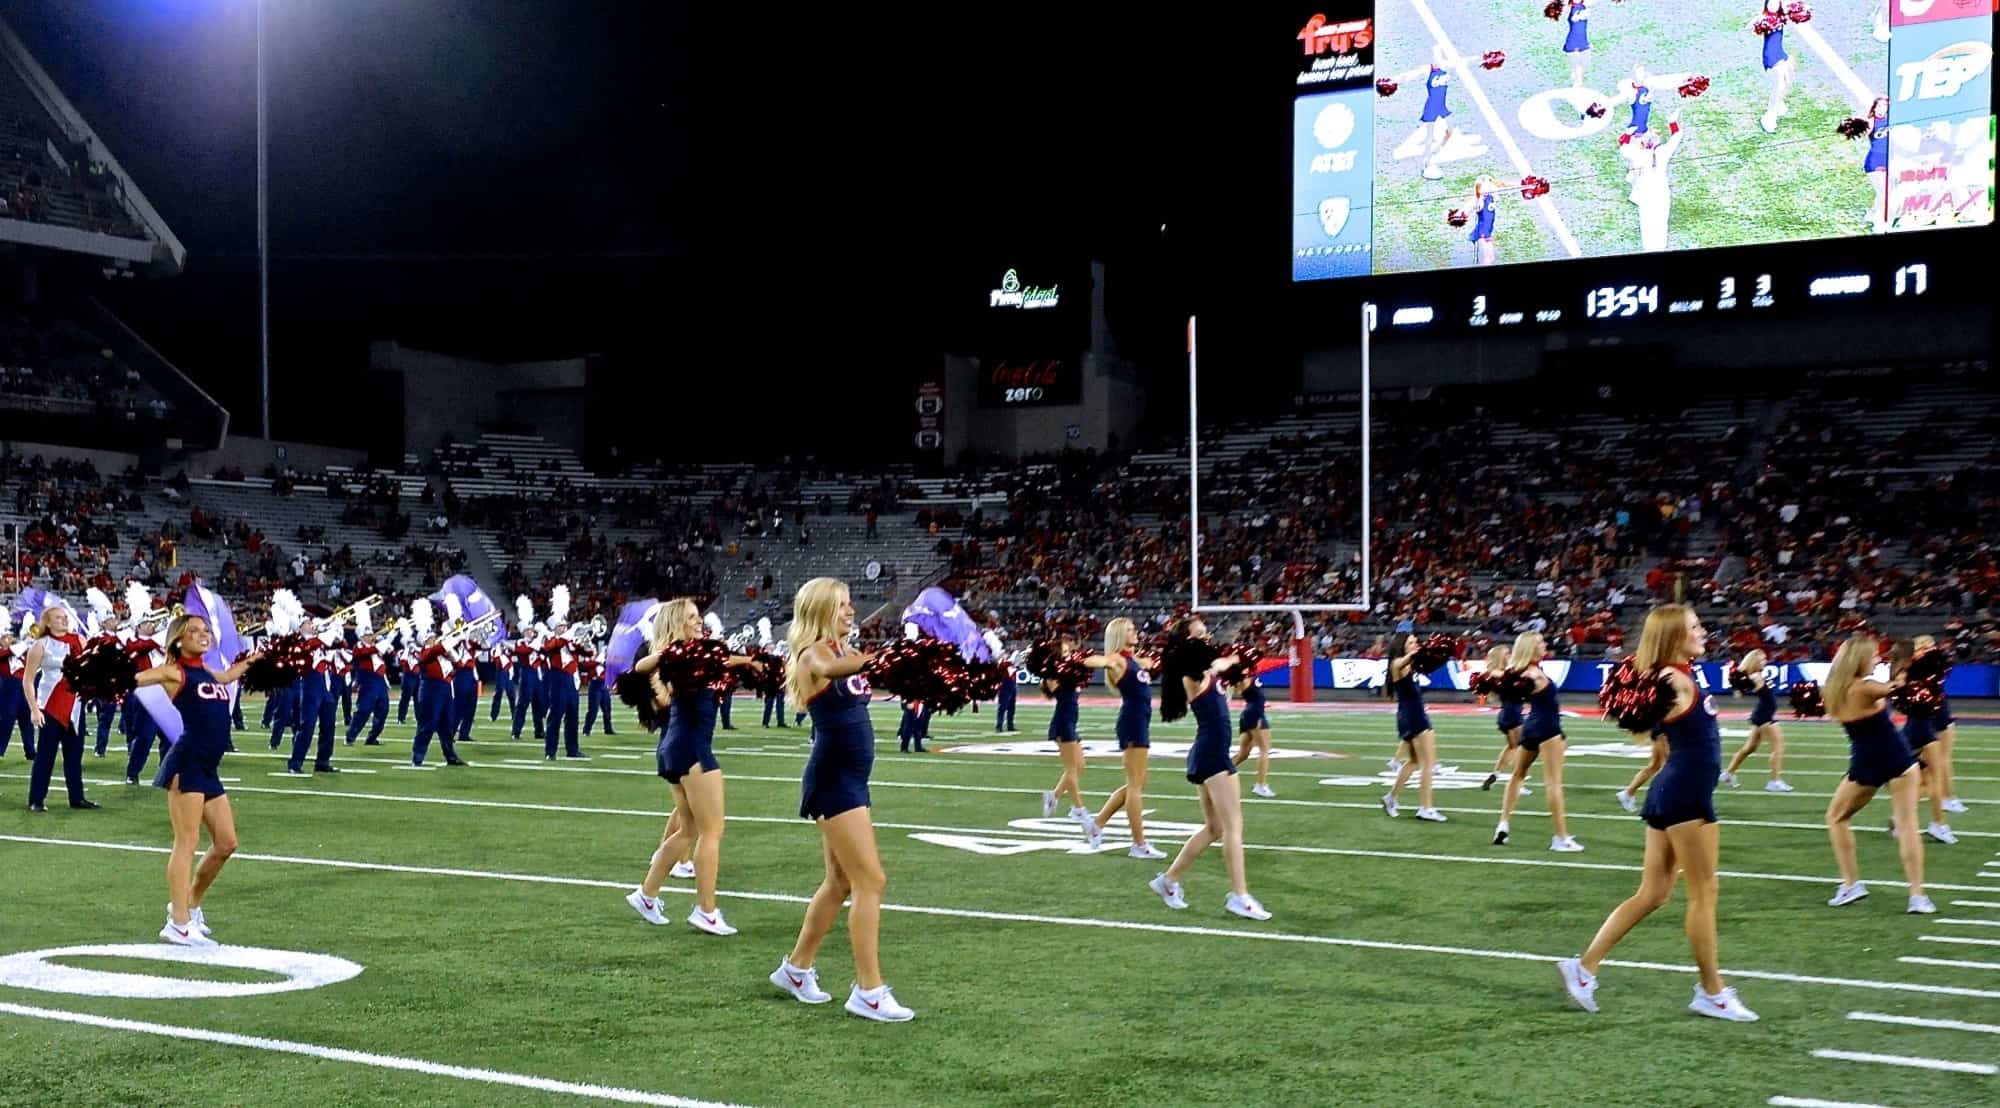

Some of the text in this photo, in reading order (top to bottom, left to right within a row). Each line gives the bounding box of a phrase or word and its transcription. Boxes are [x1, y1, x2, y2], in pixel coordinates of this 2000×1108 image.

[1720, 277, 1735, 298] 3
[1756, 274, 1771, 296] 3
[1895, 264, 1927, 295] 17
[1473, 296, 1486, 315] 3
[1587, 285, 1658, 318] 13:54
[1005, 385, 1044, 402] zero
